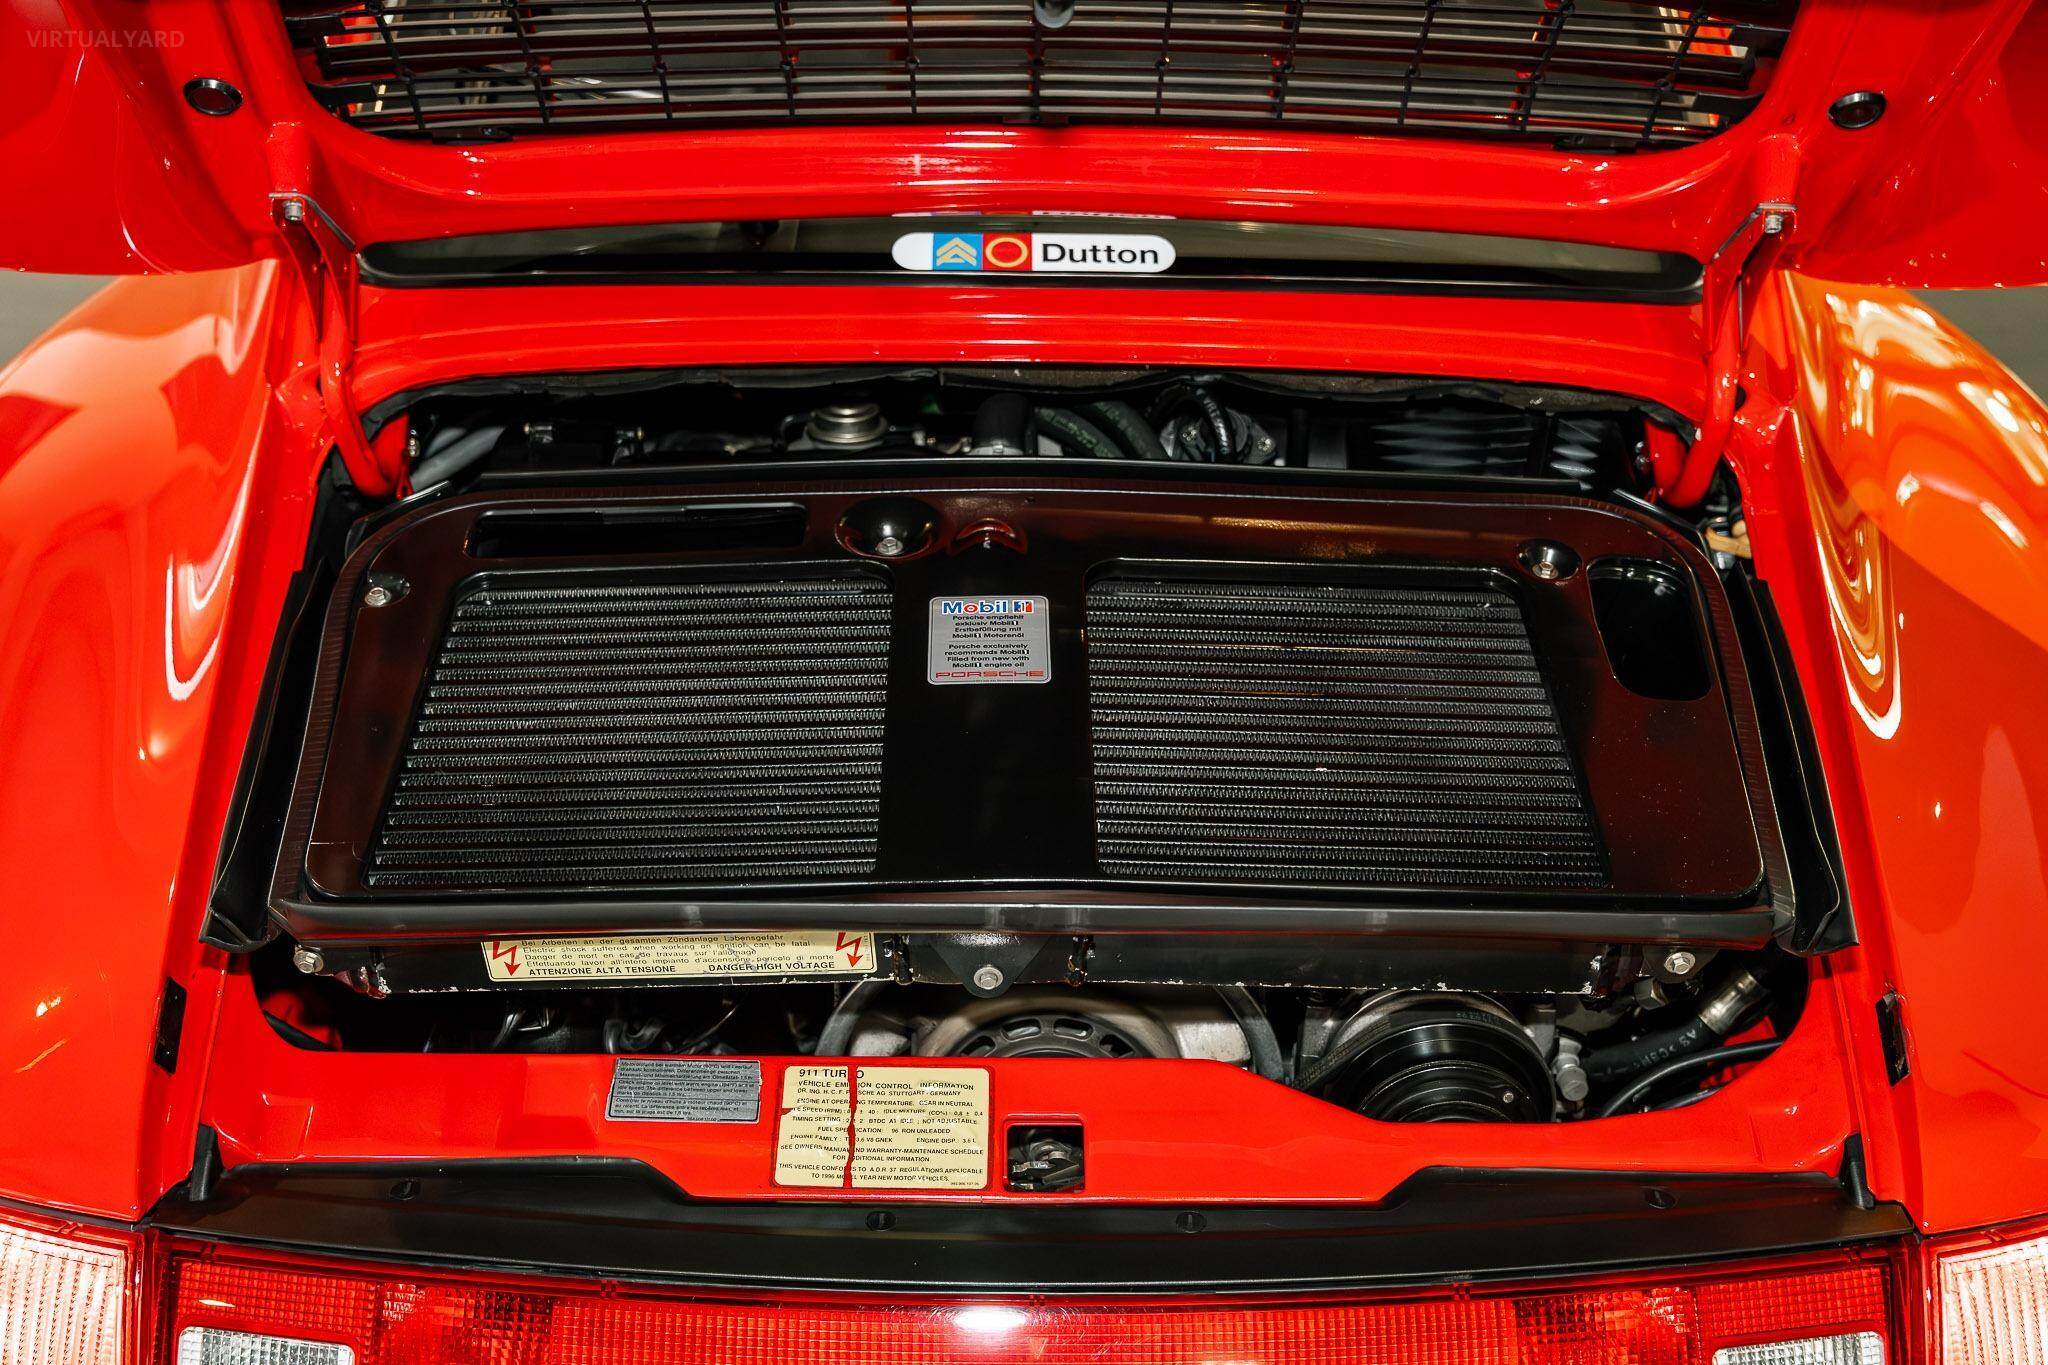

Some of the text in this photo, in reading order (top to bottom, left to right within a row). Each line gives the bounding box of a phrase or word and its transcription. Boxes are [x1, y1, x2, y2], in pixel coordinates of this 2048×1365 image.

[1042, 243, 1159, 265] Dutton
[942, 600, 1009, 616] Mobil
[953, 614, 1025, 623] Porsche empfiehlt
[955, 620, 988, 628] exklusiv
[955, 626, 1007, 635] Erstbefüllung
[983, 643, 1029, 652] exclusively
[935, 671, 1044, 679] PORSCHE
[541, 939, 578, 947] Arbeiten
[620, 937, 662, 946] gesamten
[667, 936, 719, 944] Zündanlage
[723, 934, 784, 943] Lebensgefahr
[661, 943, 695, 952] working
[717, 942, 748, 950] ignition
[524, 953, 556, 962] Danger
[526, 960, 576, 968] Effettuando
[652, 957, 690, 965] impianto
[756, 955, 791, 964] pericolo
[529, 960, 835, 976] ATTENZIONE ALTA TENSIONE DANGER HIGH VOLTAGE
[799, 1069, 865, 1079] 911 TURO
[798, 1080, 975, 1091] VEHICLE EMIION CONTROL INFORMATION
[797, 1097, 820, 1105] ENGINE
[792, 1115, 814, 1123] TIMING
[790, 1133, 814, 1141] ENGINE
[814, 1134, 838, 1142] FAMILY
[780, 1143, 793, 1151] SEE
[794, 1143, 823, 1151] OWNERS
[866, 1147, 949, 1155] WARRANTY-MAINTENANCE
[793, 1163, 820, 1171] VEHICLE
[821, 1164, 857, 1172] CONFOS
[899, 1166, 944, 1174] REGULATIONS
[944, 1167, 984, 1175] APPLICABLE
